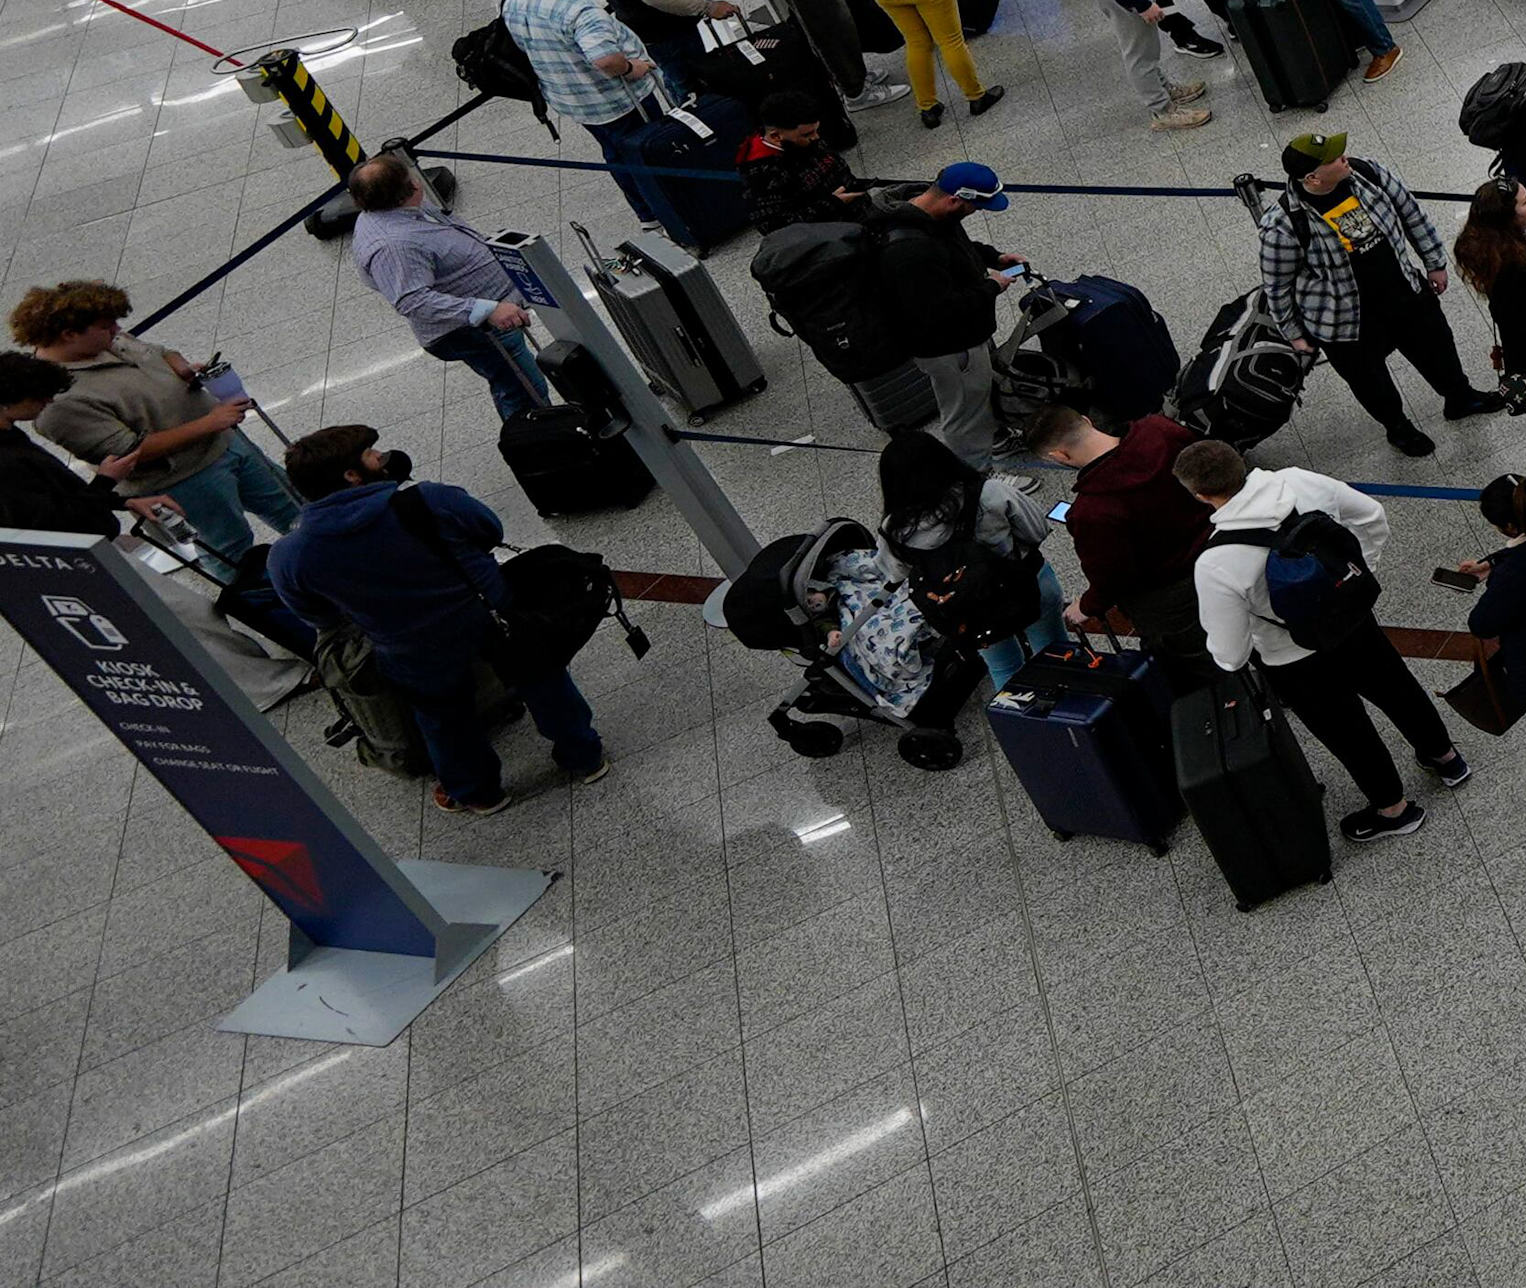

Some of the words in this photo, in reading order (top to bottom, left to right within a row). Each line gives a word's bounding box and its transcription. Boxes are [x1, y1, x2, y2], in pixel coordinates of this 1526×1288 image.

[97, 660, 160, 678] KIOSK
[87, 674, 179, 695] CHECK-IN
[182, 682, 200, 696] &
[106, 690, 148, 706] BAG
[150, 692, 203, 710] DROP
[119, 722, 171, 734] CHECK-IN
